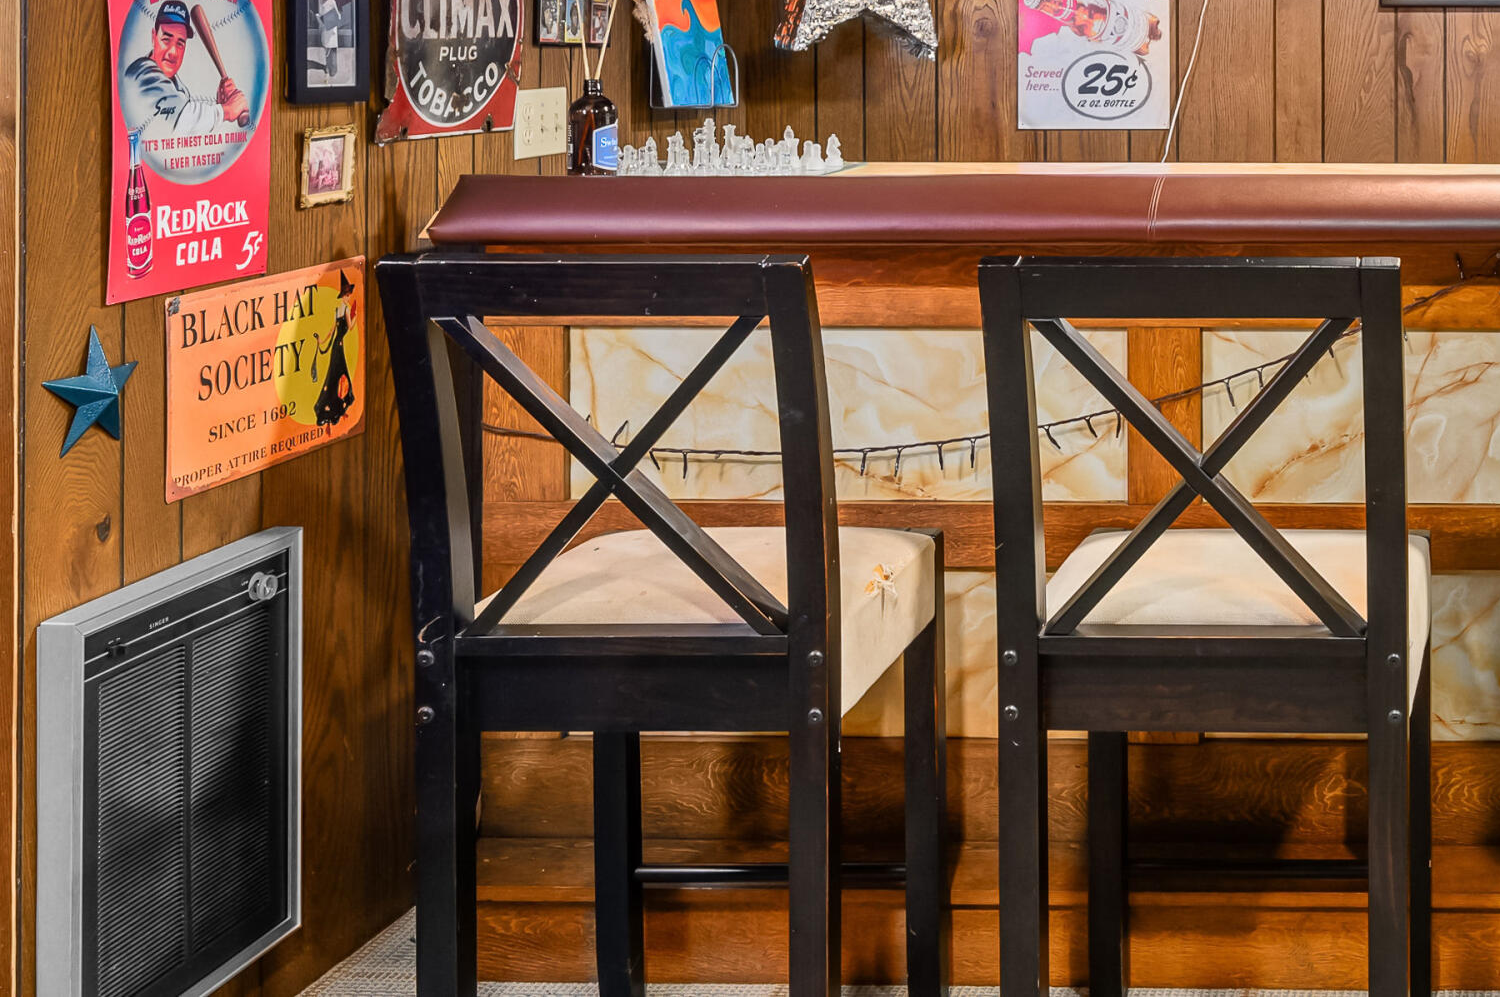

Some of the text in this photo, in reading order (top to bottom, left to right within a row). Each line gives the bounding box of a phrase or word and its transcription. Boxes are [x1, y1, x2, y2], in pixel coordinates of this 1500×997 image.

[439, 46, 478, 61] PLUG
[1025, 66, 1063, 79] Served
[1078, 63, 1138, 96] 25¢
[410, 61, 499, 118] TOBACCO
[1077, 99, 1086, 108] 12
[1103, 99, 1136, 108] BOTTLE
[154, 97, 176, 120] Says
[161, 138, 175, 150] THE
[177, 136, 202, 149] FINEST
[204, 134, 223, 146] COLA
[225, 131, 248, 144] DRINK
[171, 156, 190, 170] EVER
[176, 237, 222, 266] COLA
[181, 284, 318, 349] BLACK HAT
[198, 339, 306, 401] SOCIETY
[208, 401, 297, 443] SINCE 1692
[174, 427, 324, 488] PROPER ATTIRE REQUIRED
